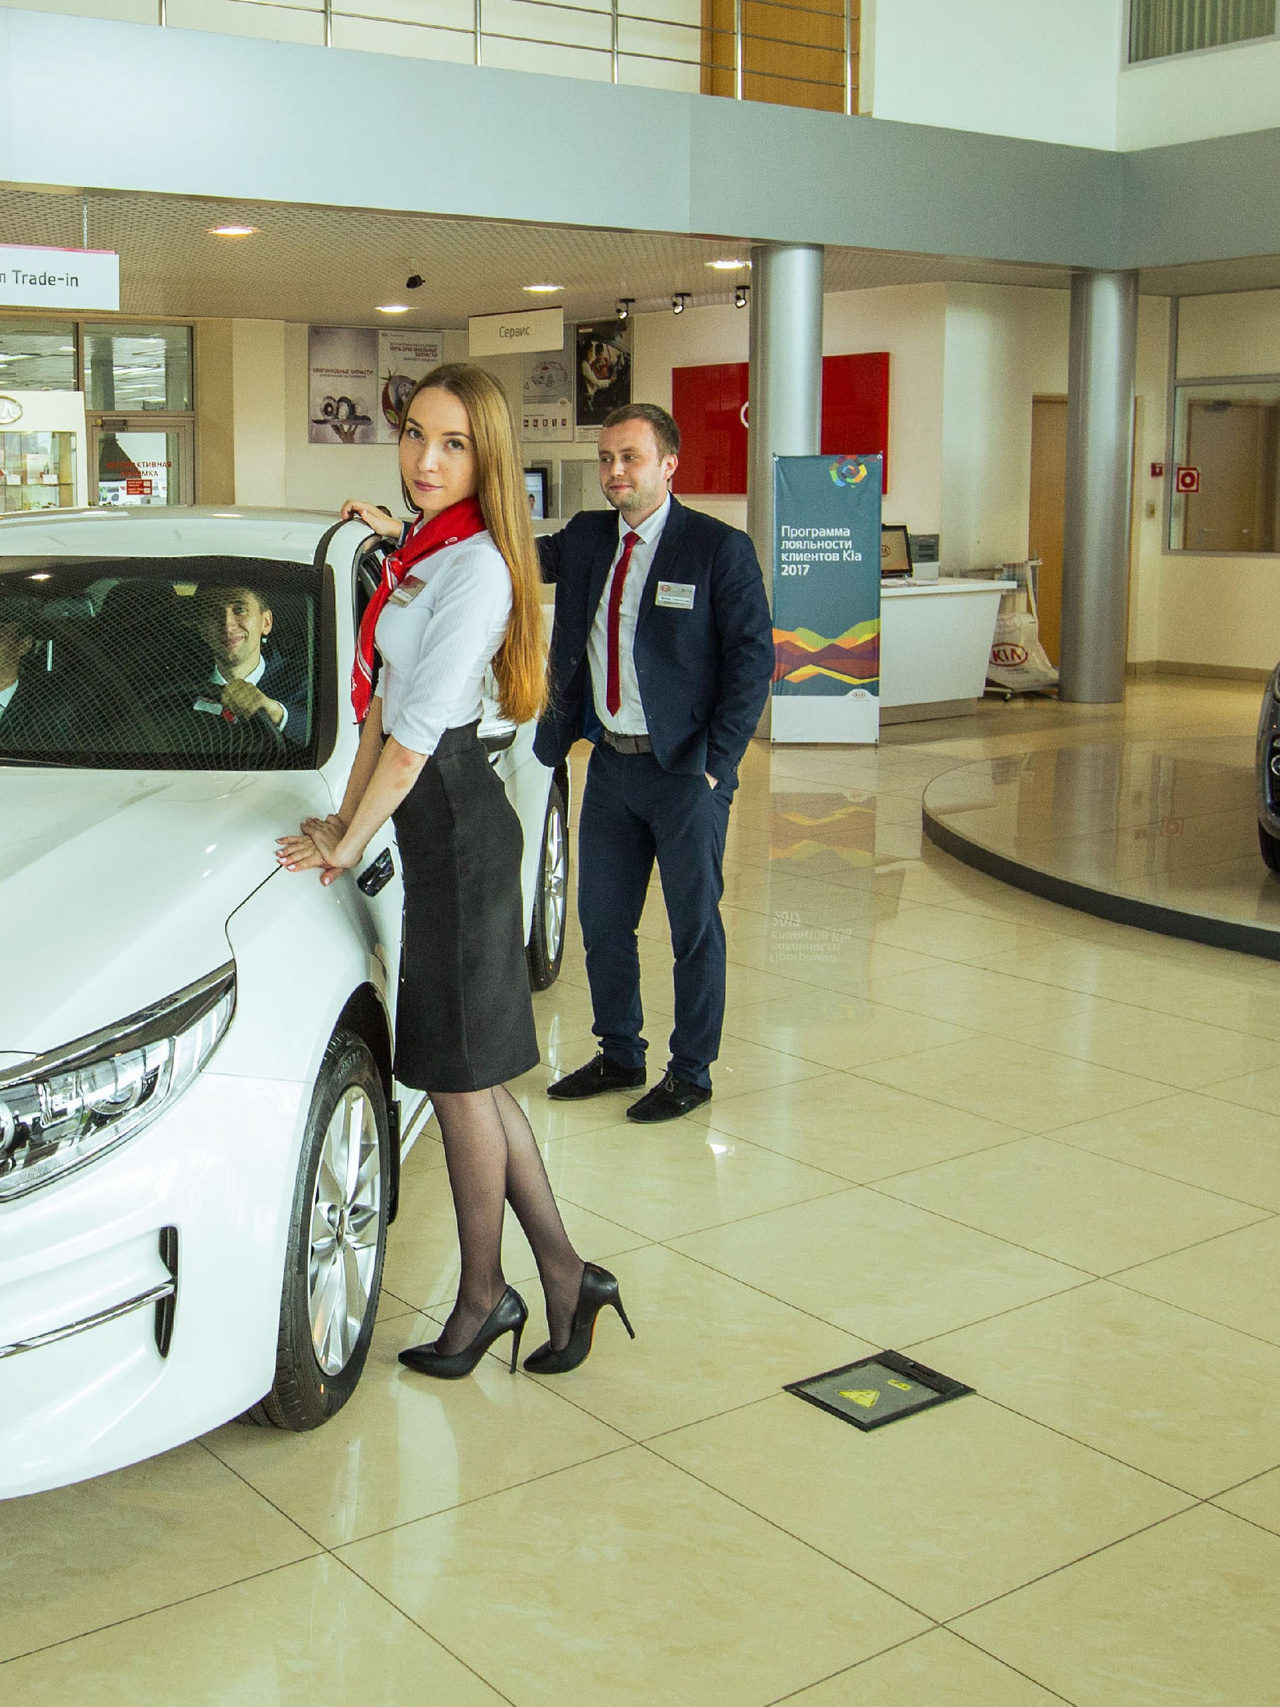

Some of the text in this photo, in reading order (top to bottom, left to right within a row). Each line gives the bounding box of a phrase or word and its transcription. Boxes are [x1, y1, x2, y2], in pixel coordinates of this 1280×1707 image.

[12, 270, 79, 287] Trade-in
[499, 325, 531, 339] Сервис
[781, 525, 851, 538] Программа
[780, 540, 853, 549] лояльности
[781, 550, 862, 561] клиентов Kia
[781, 565, 810, 576] 2017
[992, 649, 1022, 662] KIA
